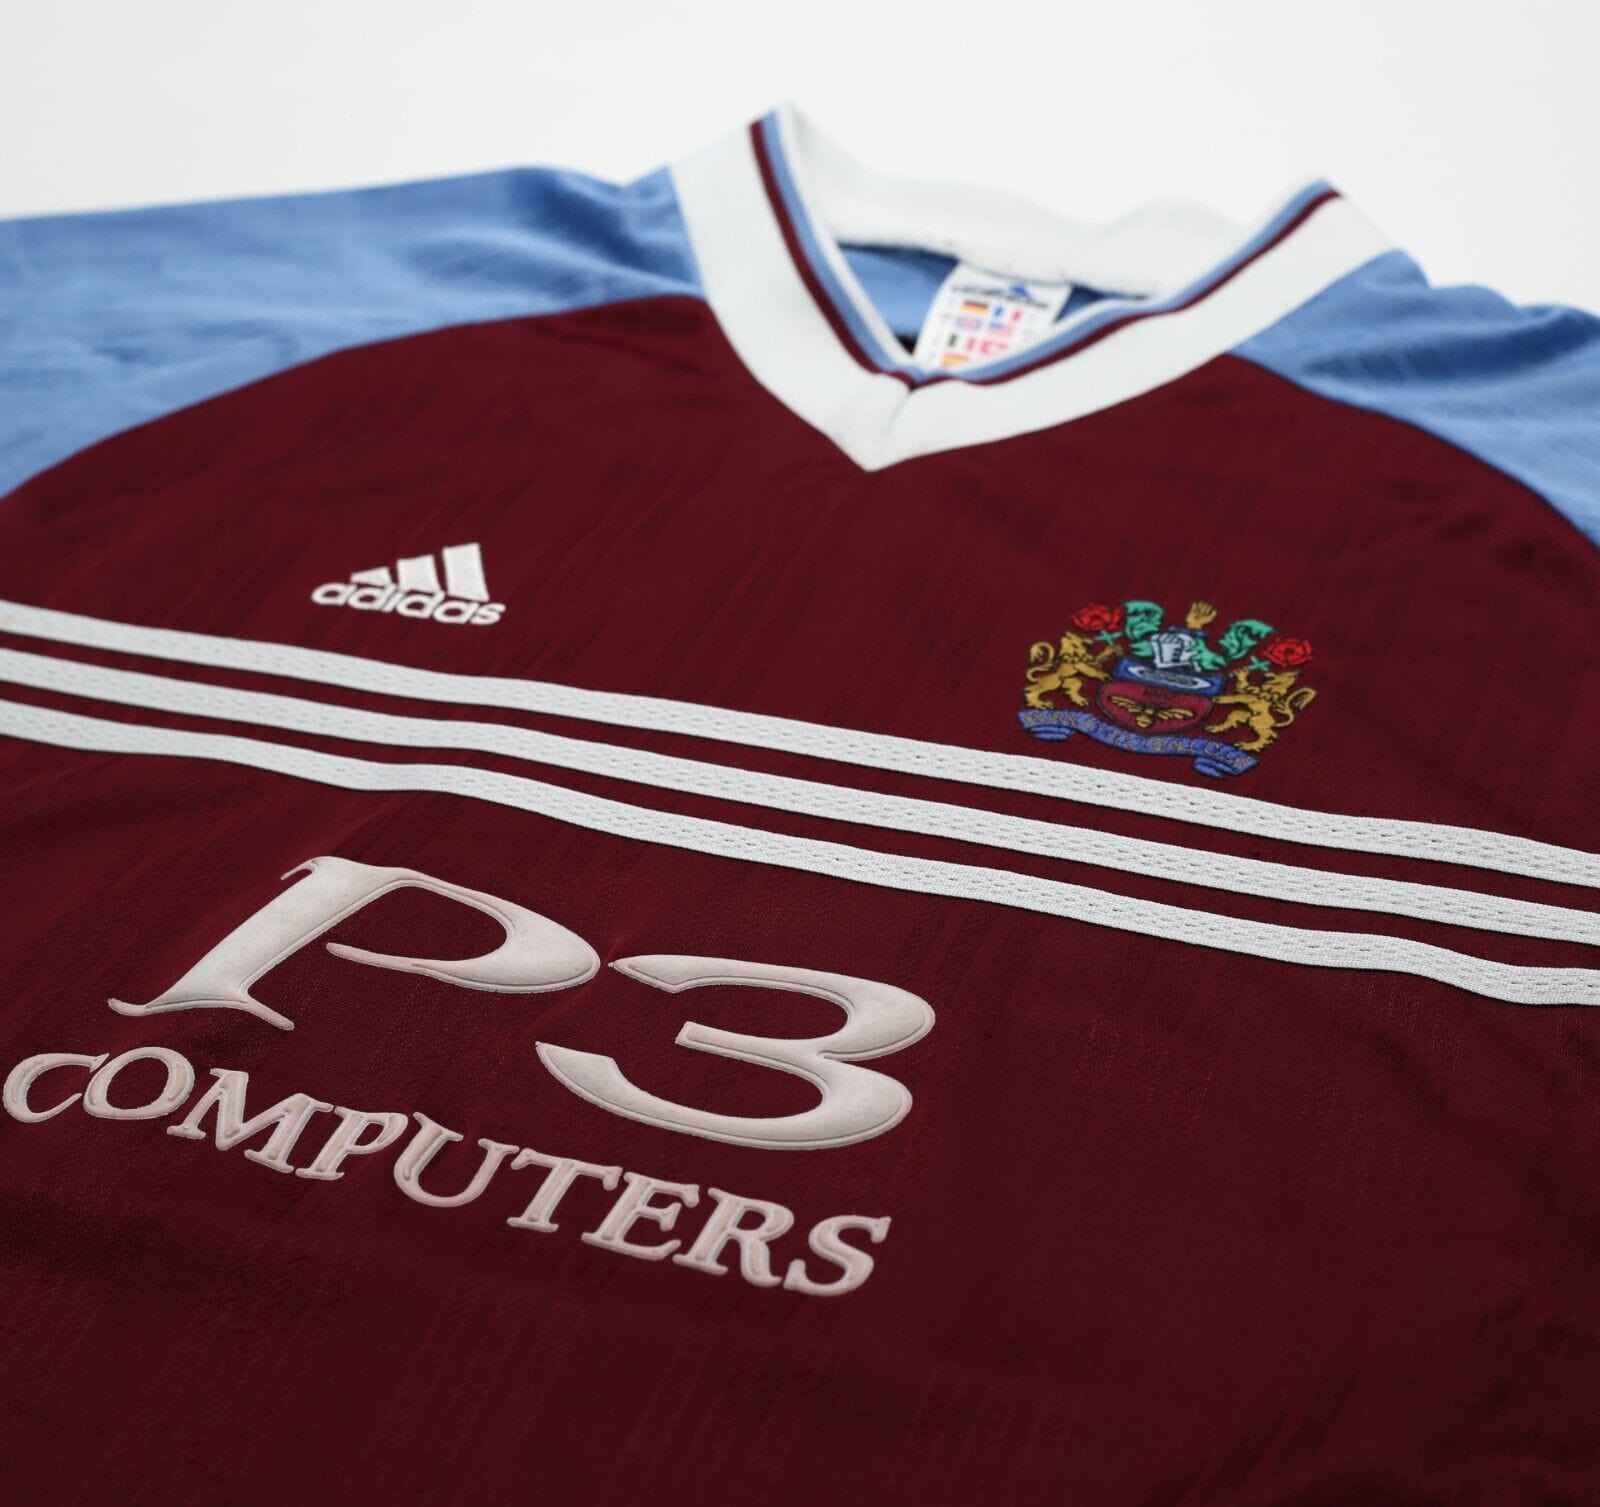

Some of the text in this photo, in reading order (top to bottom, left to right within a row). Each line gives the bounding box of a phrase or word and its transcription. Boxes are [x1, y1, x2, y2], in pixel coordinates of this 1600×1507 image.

[311, 582, 506, 625] adidas
[108, 855, 936, 1151] P3
[2, 1046, 892, 1298] COMPUTERS
